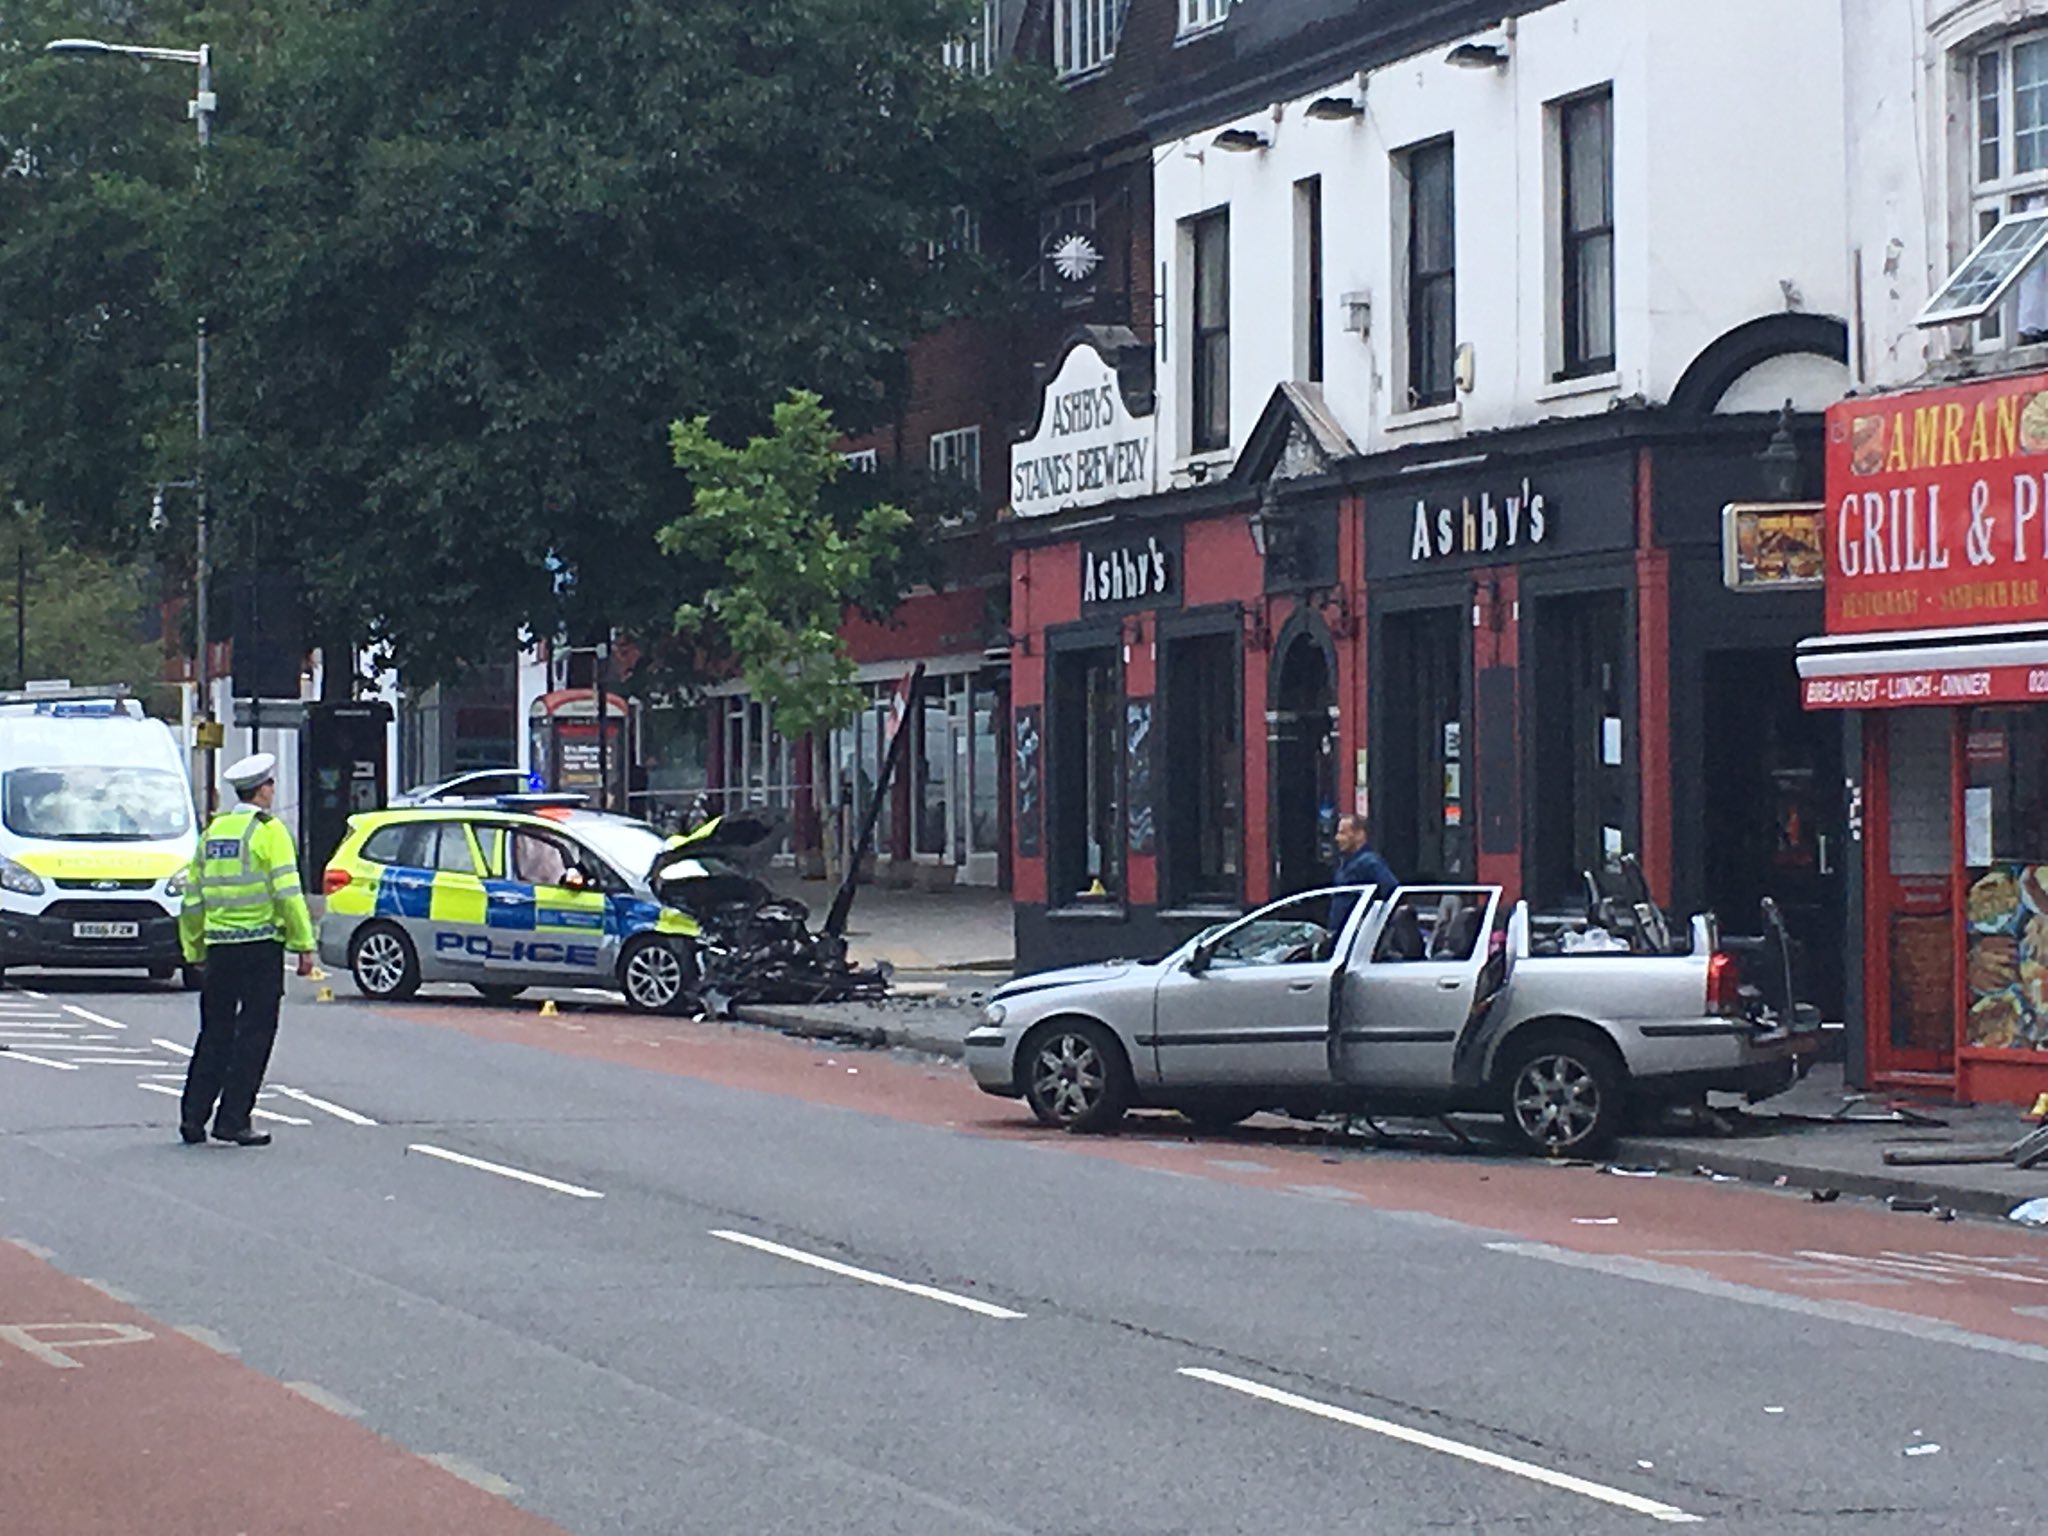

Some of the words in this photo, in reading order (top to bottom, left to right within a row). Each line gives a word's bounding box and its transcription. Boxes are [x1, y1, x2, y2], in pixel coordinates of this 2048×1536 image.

[1051, 384, 1114, 437] ASHBY'S
[1886, 395, 2019, 473] AMRAN
[1014, 453, 1073, 502] STAINES
[1077, 437, 1149, 491] BREWERY
[1411, 477, 1545, 560] Ashby's
[1838, 484, 1949, 577] GRILL
[1966, 479, 1996, 566] &
[1083, 537, 1166, 602] Ashby's
[1806, 679, 1879, 703] BREAKFAST
[1887, 675, 1934, 700] LUNCH
[1940, 672, 1992, 697] DINNER
[435, 931, 600, 967] POLICE
